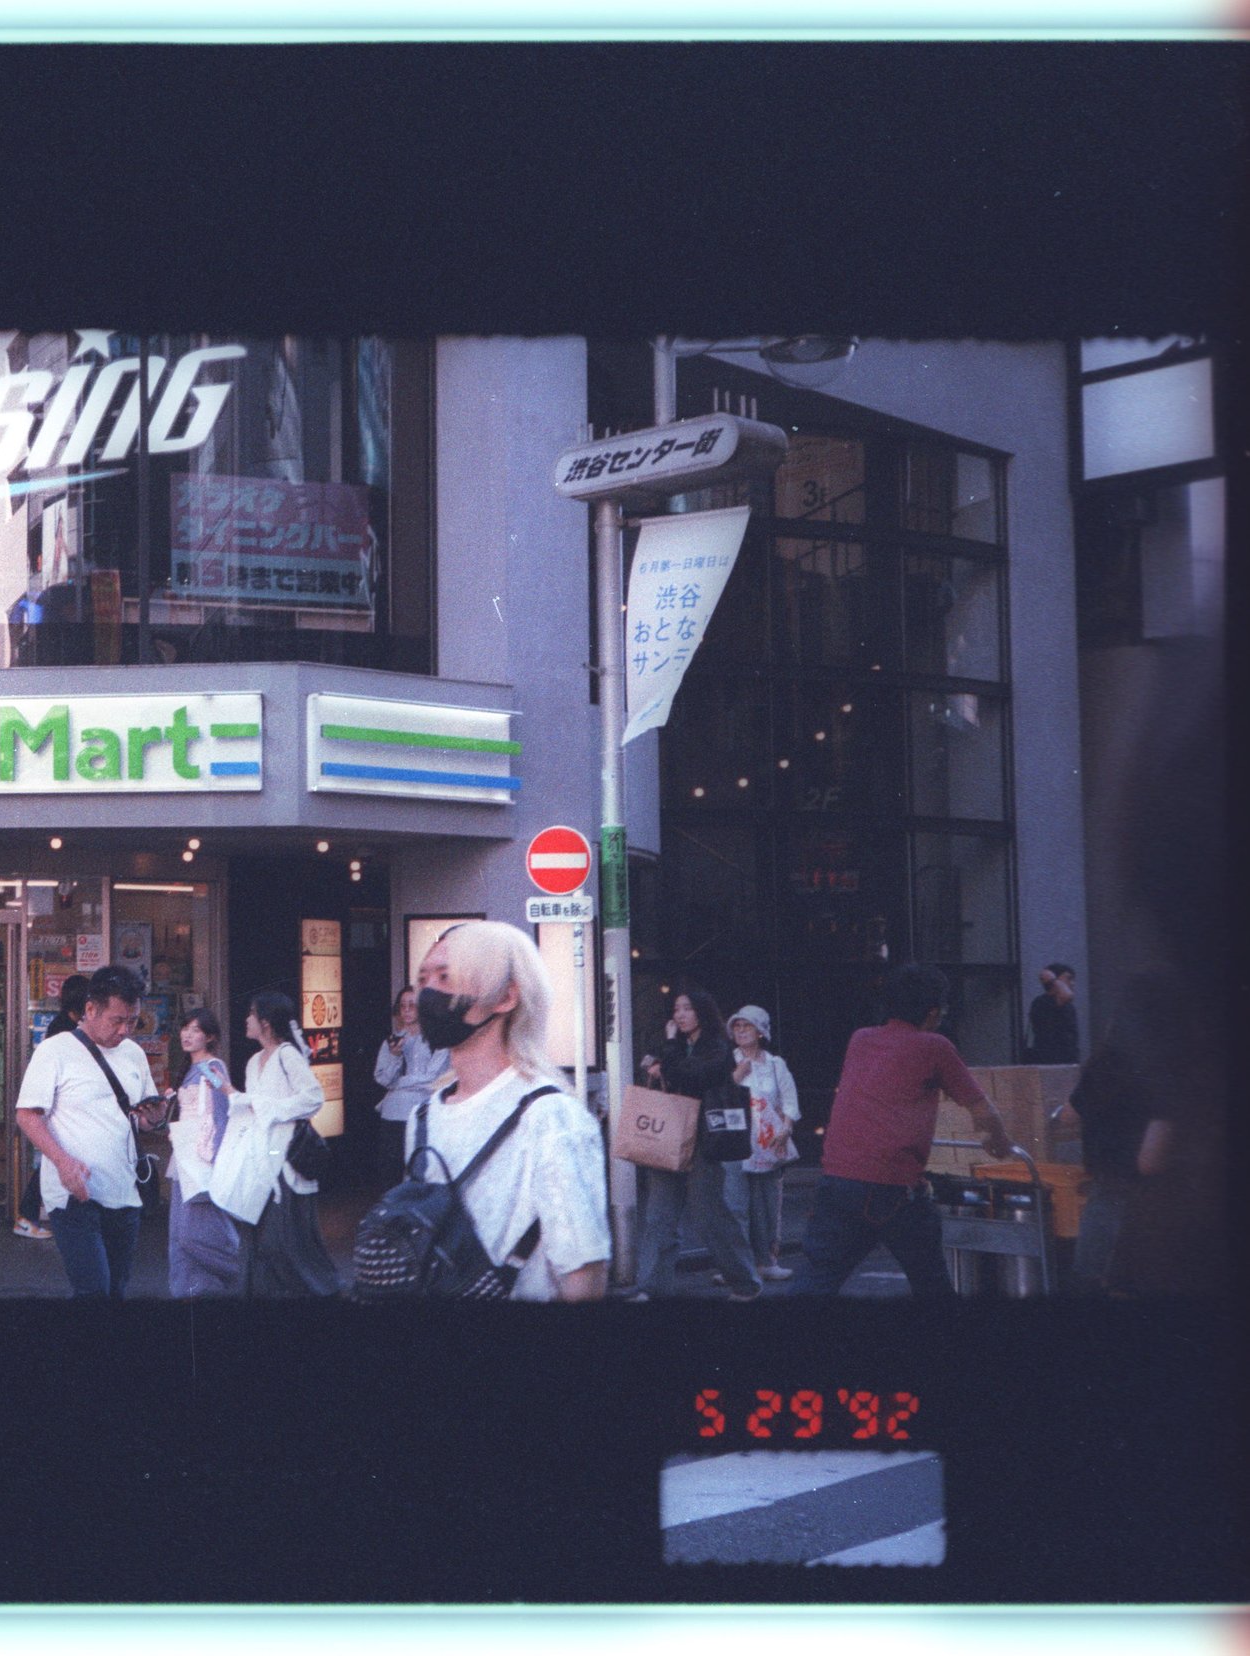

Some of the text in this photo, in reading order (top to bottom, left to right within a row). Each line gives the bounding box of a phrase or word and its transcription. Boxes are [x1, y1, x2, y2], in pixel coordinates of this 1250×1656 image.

[563, 427, 724, 484] 渋谷センター街
[176, 481, 286, 513] カラオケ
[176, 515, 362, 553] ダイニングバー
[655, 583, 702, 610] 渋谷
[634, 615, 709, 643] おとな
[530, 902, 591, 918] 自転車を除く
[635, 1114, 666, 1134] GU
